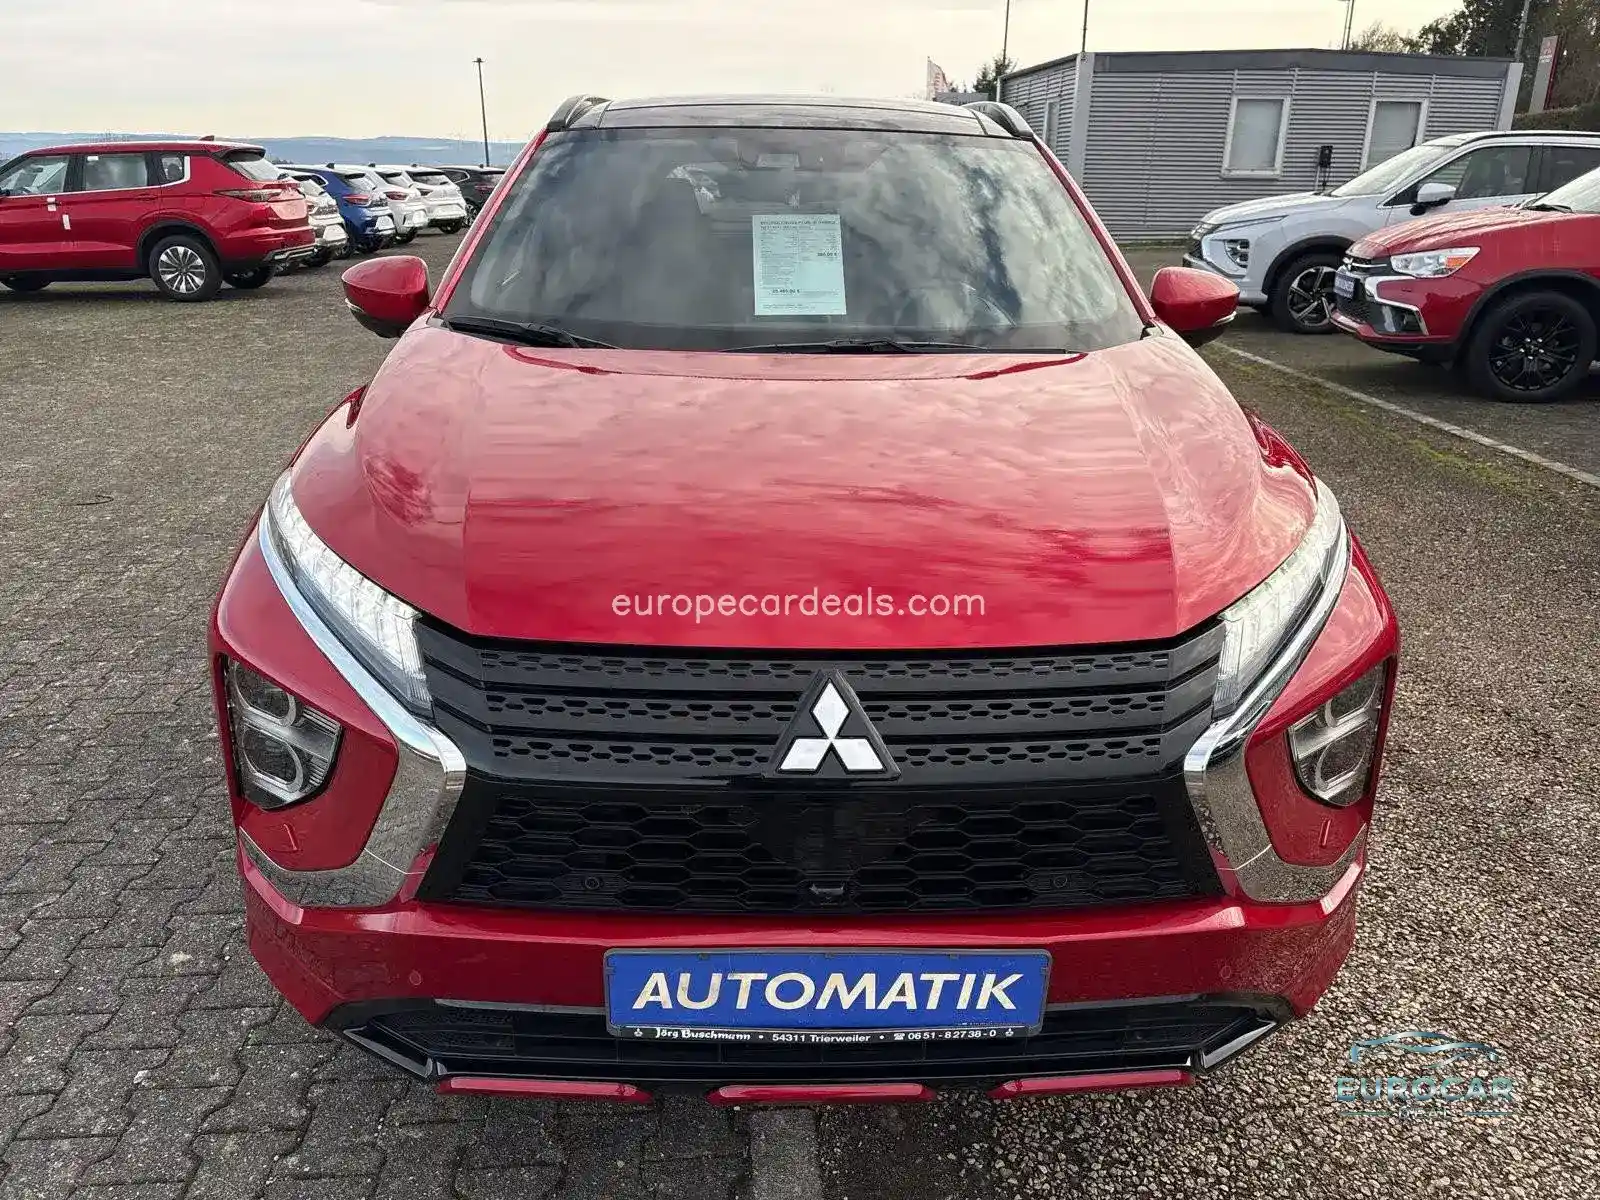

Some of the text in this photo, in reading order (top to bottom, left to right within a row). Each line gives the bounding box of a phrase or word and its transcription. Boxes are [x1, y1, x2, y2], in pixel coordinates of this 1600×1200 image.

[632, 972, 1025, 1011] AUTOMATIK
[655, 1027, 679, 1040] Jörg
[681, 1028, 751, 1041] Buschmann
[772, 1033, 806, 1042] 54311
[809, 1034, 871, 1043] Trierweiler
